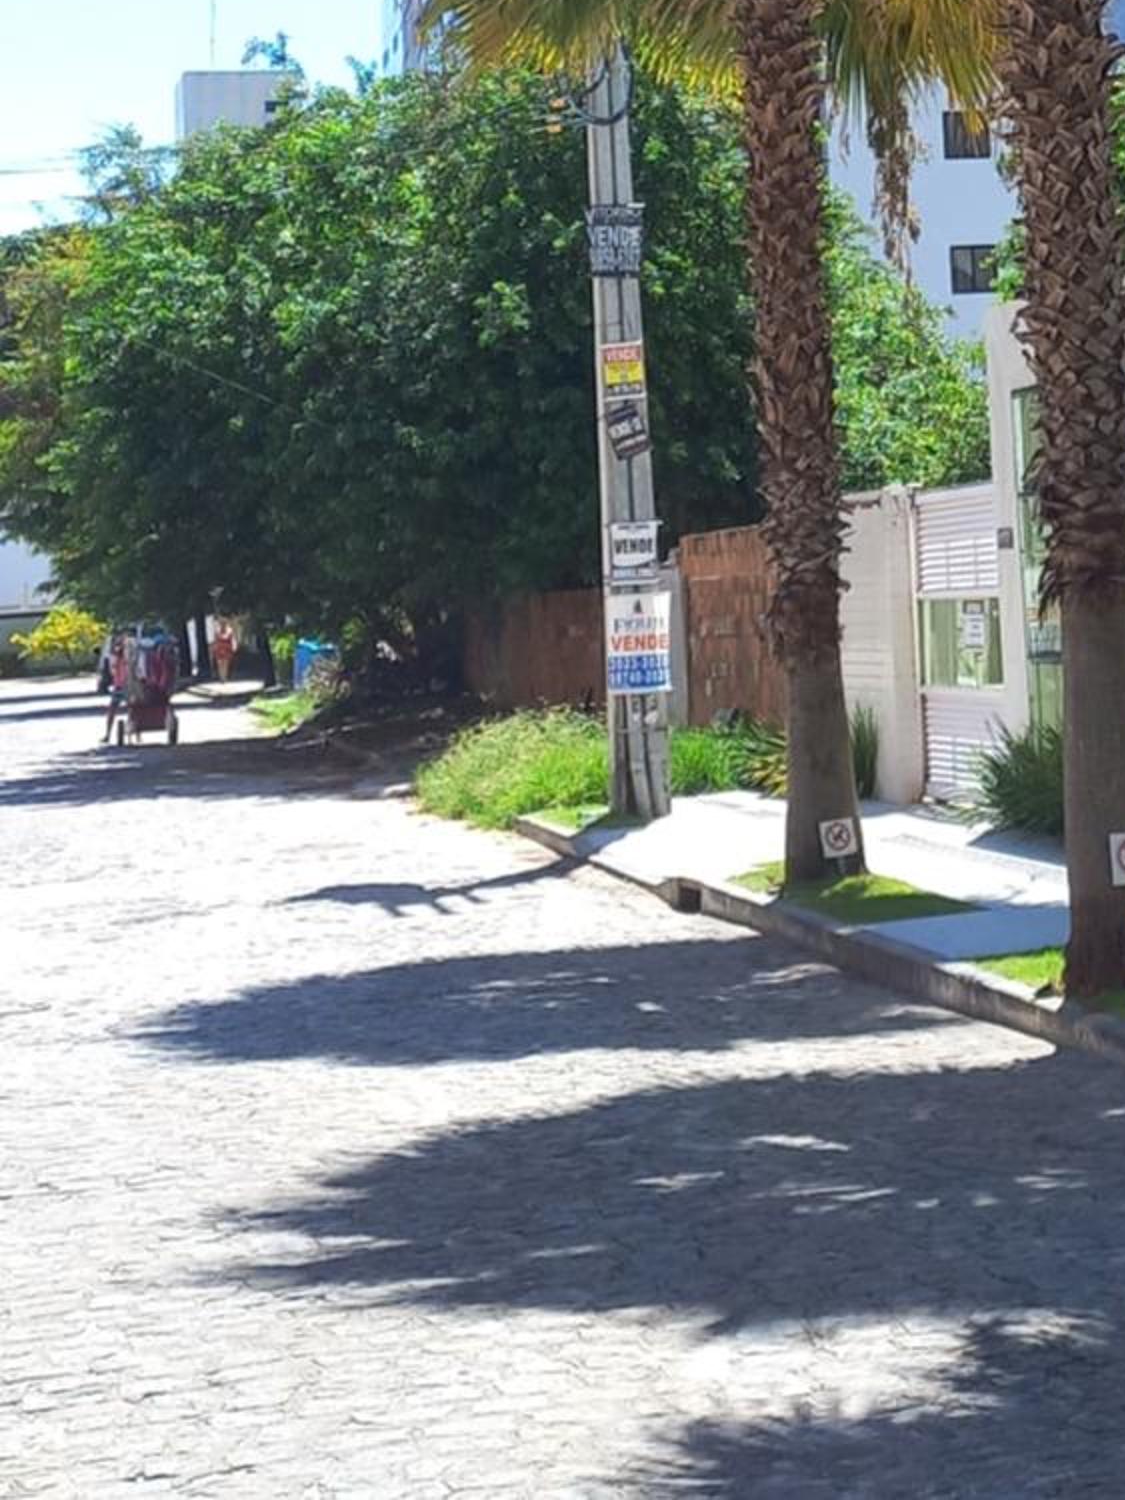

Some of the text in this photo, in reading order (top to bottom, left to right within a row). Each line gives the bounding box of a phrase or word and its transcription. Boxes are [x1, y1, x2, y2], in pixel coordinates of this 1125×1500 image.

[587, 226, 643, 247] VENDE
[614, 538, 653, 554] VENDE
[611, 633, 671, 652] VENDE
